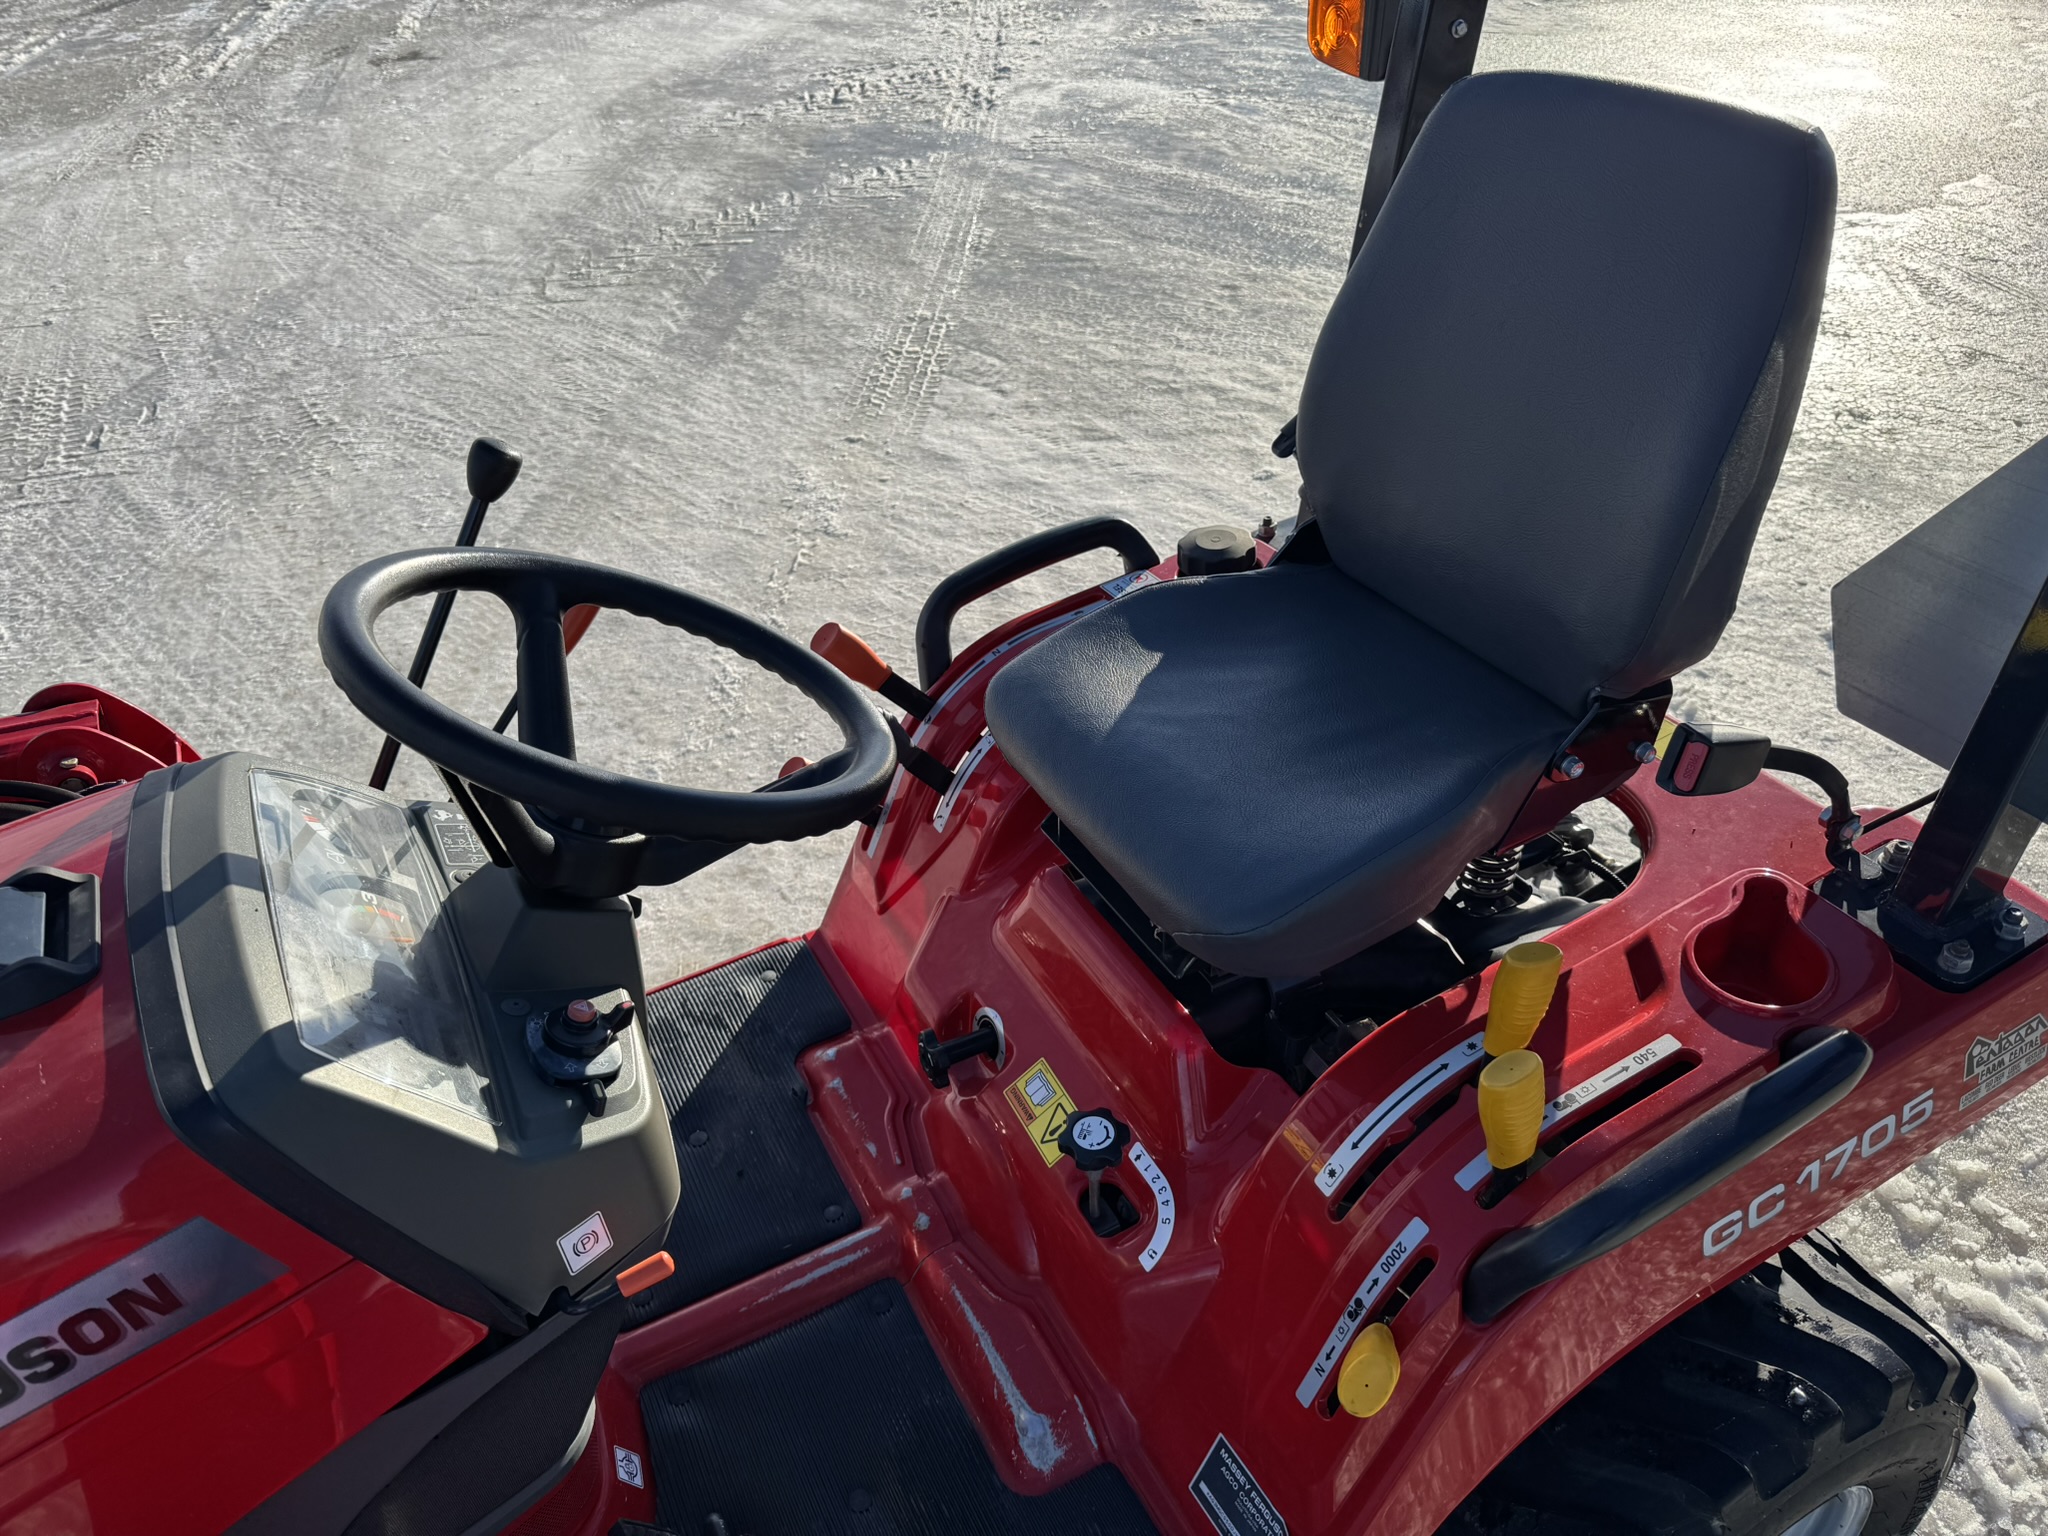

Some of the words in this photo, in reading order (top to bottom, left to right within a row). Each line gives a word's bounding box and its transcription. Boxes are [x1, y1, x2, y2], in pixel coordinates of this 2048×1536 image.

[1683, 753, 1699, 779] PRESS
[1632, 1048, 1658, 1065] 540
[1980, 1057, 2005, 1080] FARM
[2009, 1036, 2040, 1062] CENTRE
[1010, 1087, 1029, 1116] WARNING
[1144, 1164, 1151, 1172] 1
[1151, 1174, 1160, 1183] 2
[1703, 1183, 1786, 1257] GC
[1796, 1088, 1934, 1193] 1705
[1158, 1186, 1167, 1195] 3
[1162, 1217, 1171, 1225] 5
[1380, 1241, 1407, 1274] 2000
[1314, 1362, 1326, 1378] N
[1220, 1448, 1251, 1490] MASSEY
[1221, 1466, 1238, 1490] AGCO
